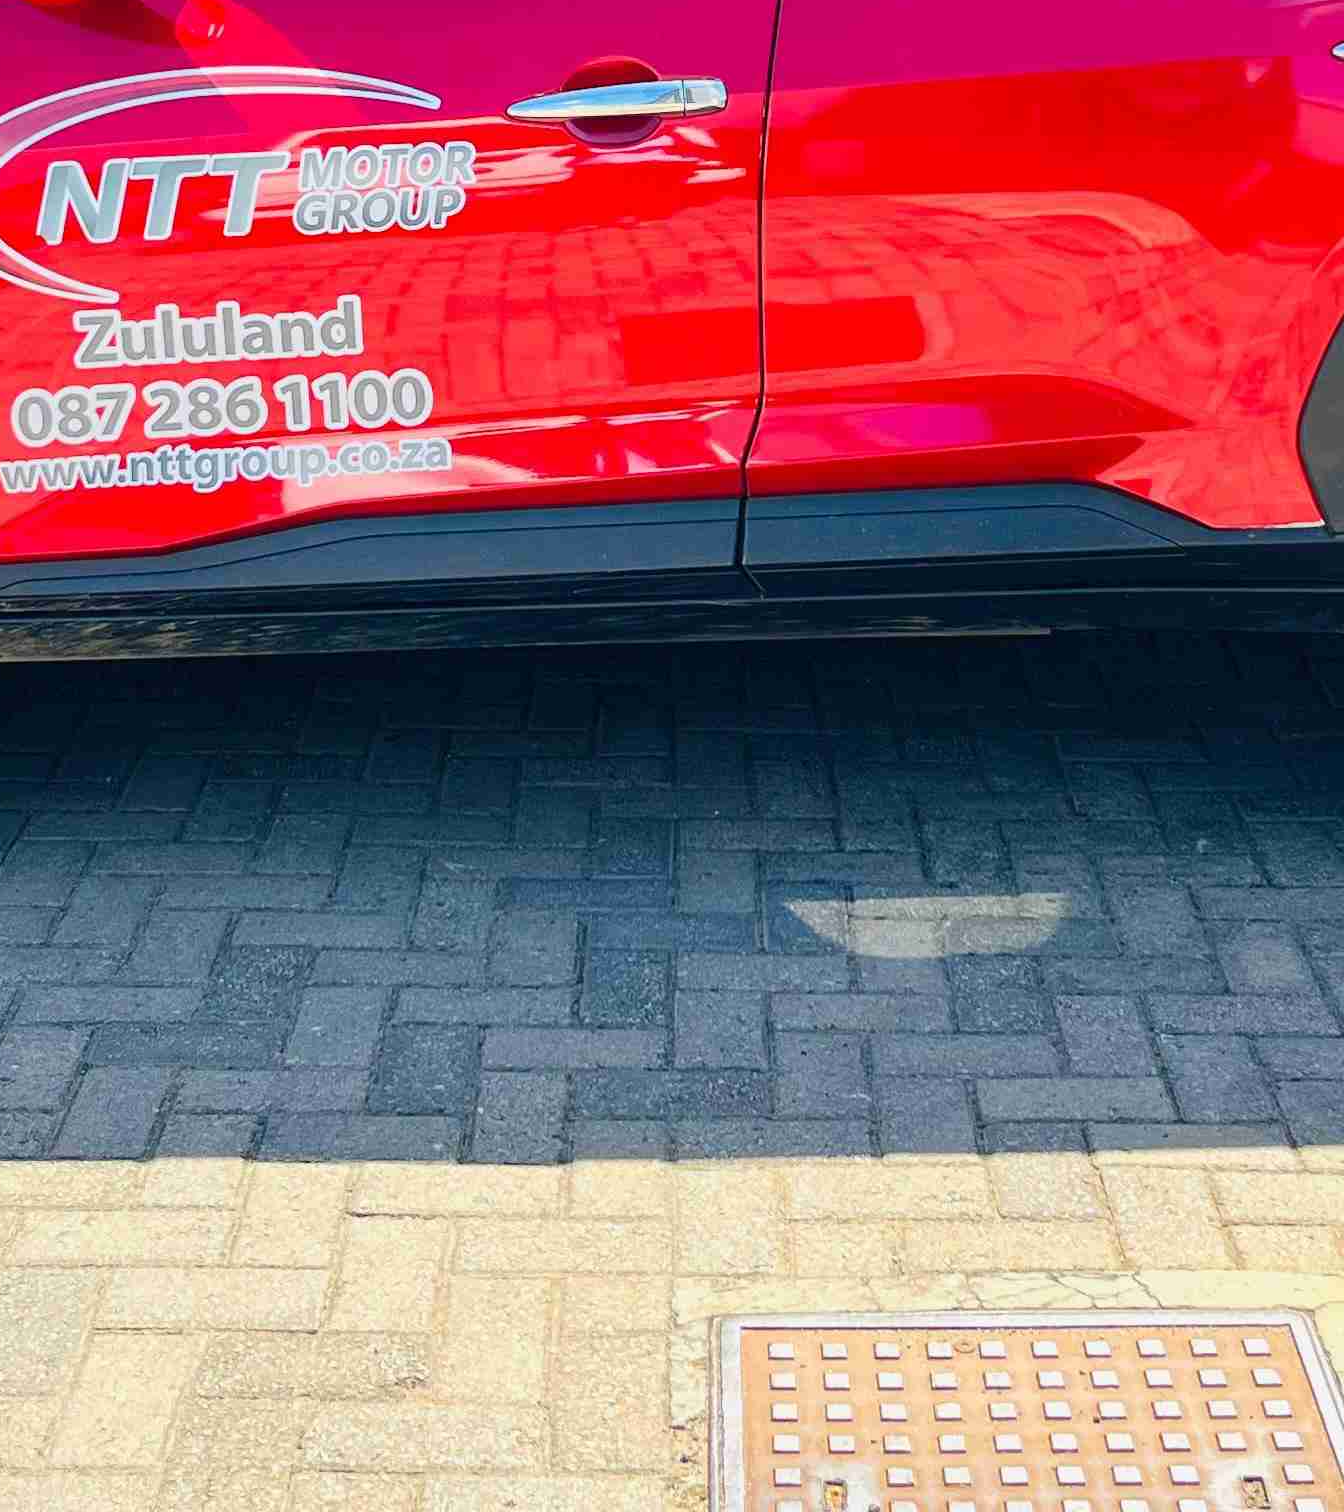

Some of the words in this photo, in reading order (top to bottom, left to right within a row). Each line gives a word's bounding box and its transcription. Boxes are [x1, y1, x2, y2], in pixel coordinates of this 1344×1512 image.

[35, 151, 290, 245] NTT
[299, 141, 476, 191] MOTOR
[293, 187, 465, 235] GROUP
[73, 294, 364, 369] Zululand
[11, 383, 134, 447] 087
[144, 376, 268, 439] 286
[273, 368, 433, 431] 1100
